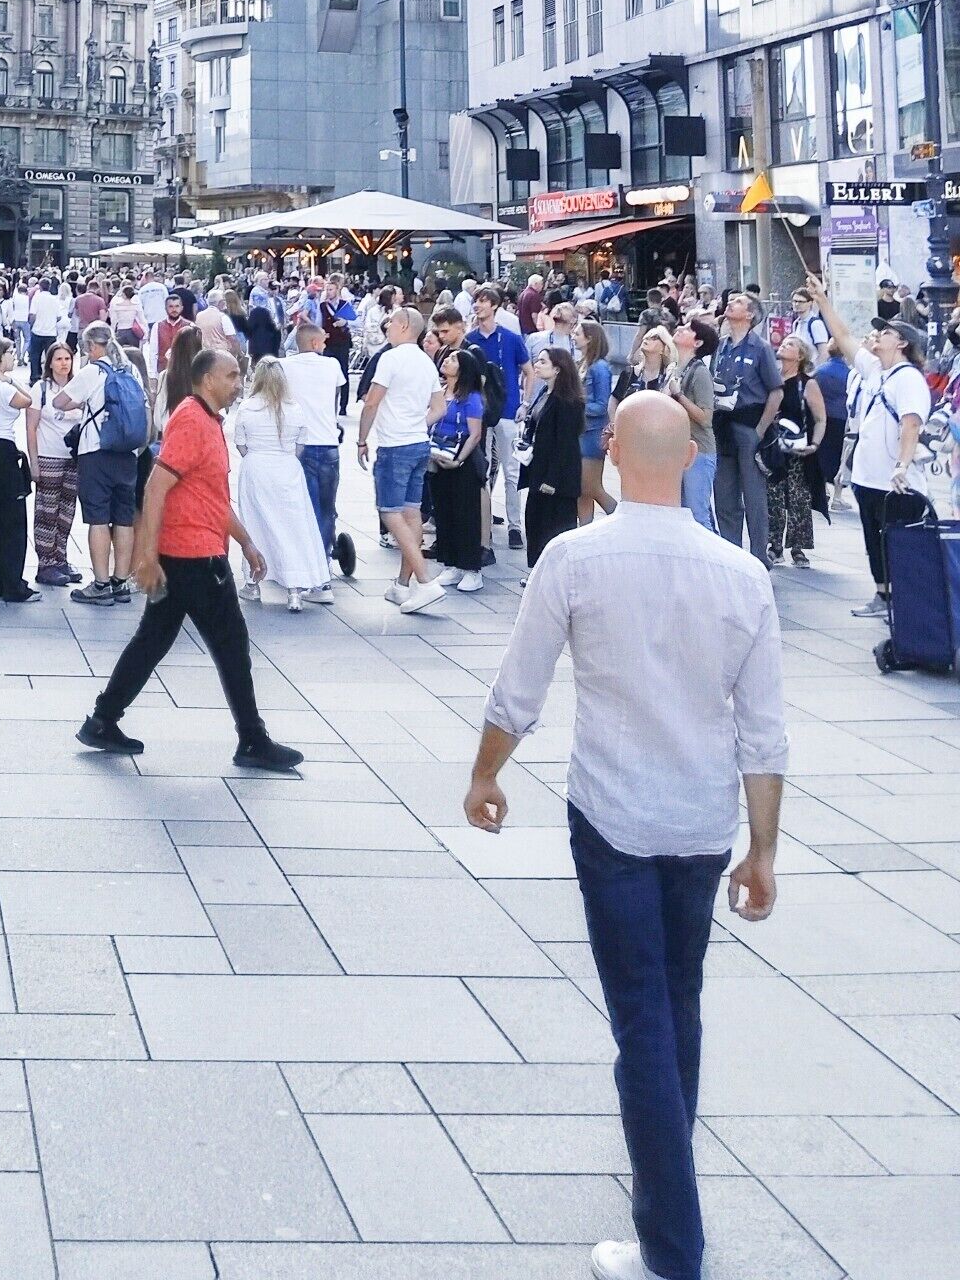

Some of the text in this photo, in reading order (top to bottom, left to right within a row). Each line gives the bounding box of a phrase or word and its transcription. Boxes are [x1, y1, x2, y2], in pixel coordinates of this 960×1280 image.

[35, 172, 65, 181] OMEGA
[103, 175, 132, 184] OMEGA
[832, 182, 907, 200] ELLERT
